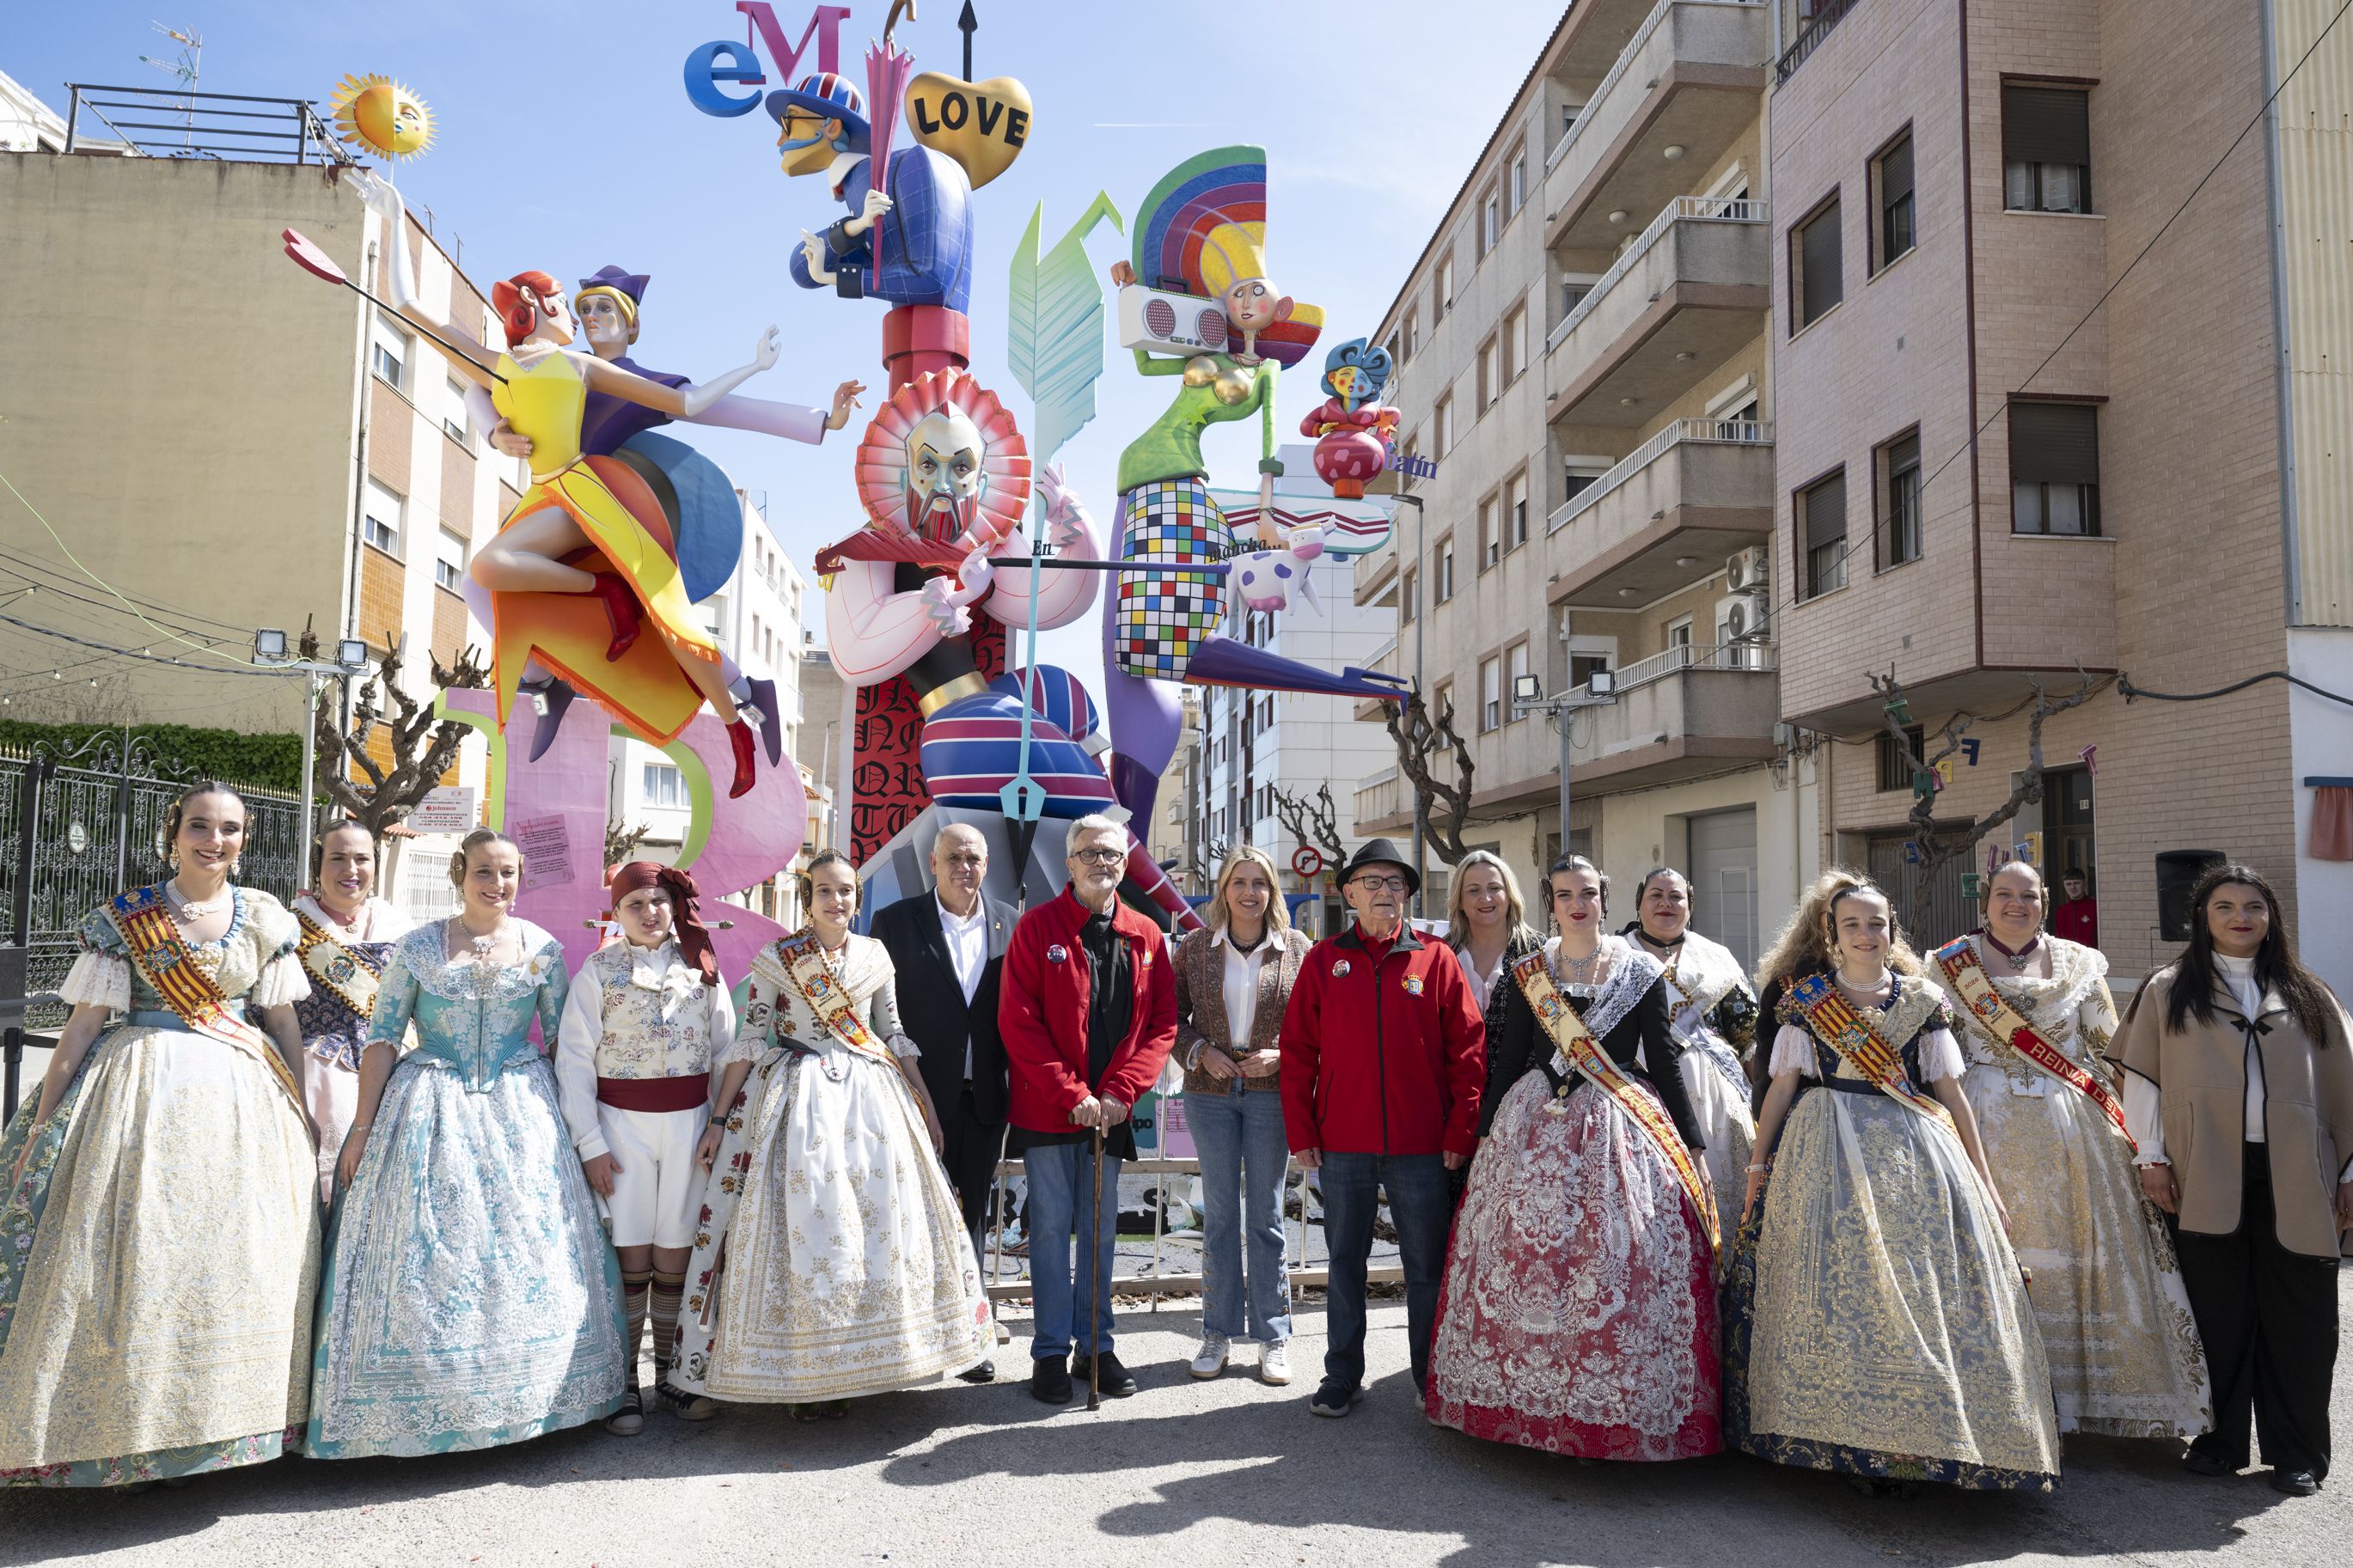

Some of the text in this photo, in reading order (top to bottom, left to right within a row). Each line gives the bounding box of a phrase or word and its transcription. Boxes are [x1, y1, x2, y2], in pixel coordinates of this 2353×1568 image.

[914, 92, 1029, 149] LOVE
[2029, 1042, 2120, 1120] REINA DEL
